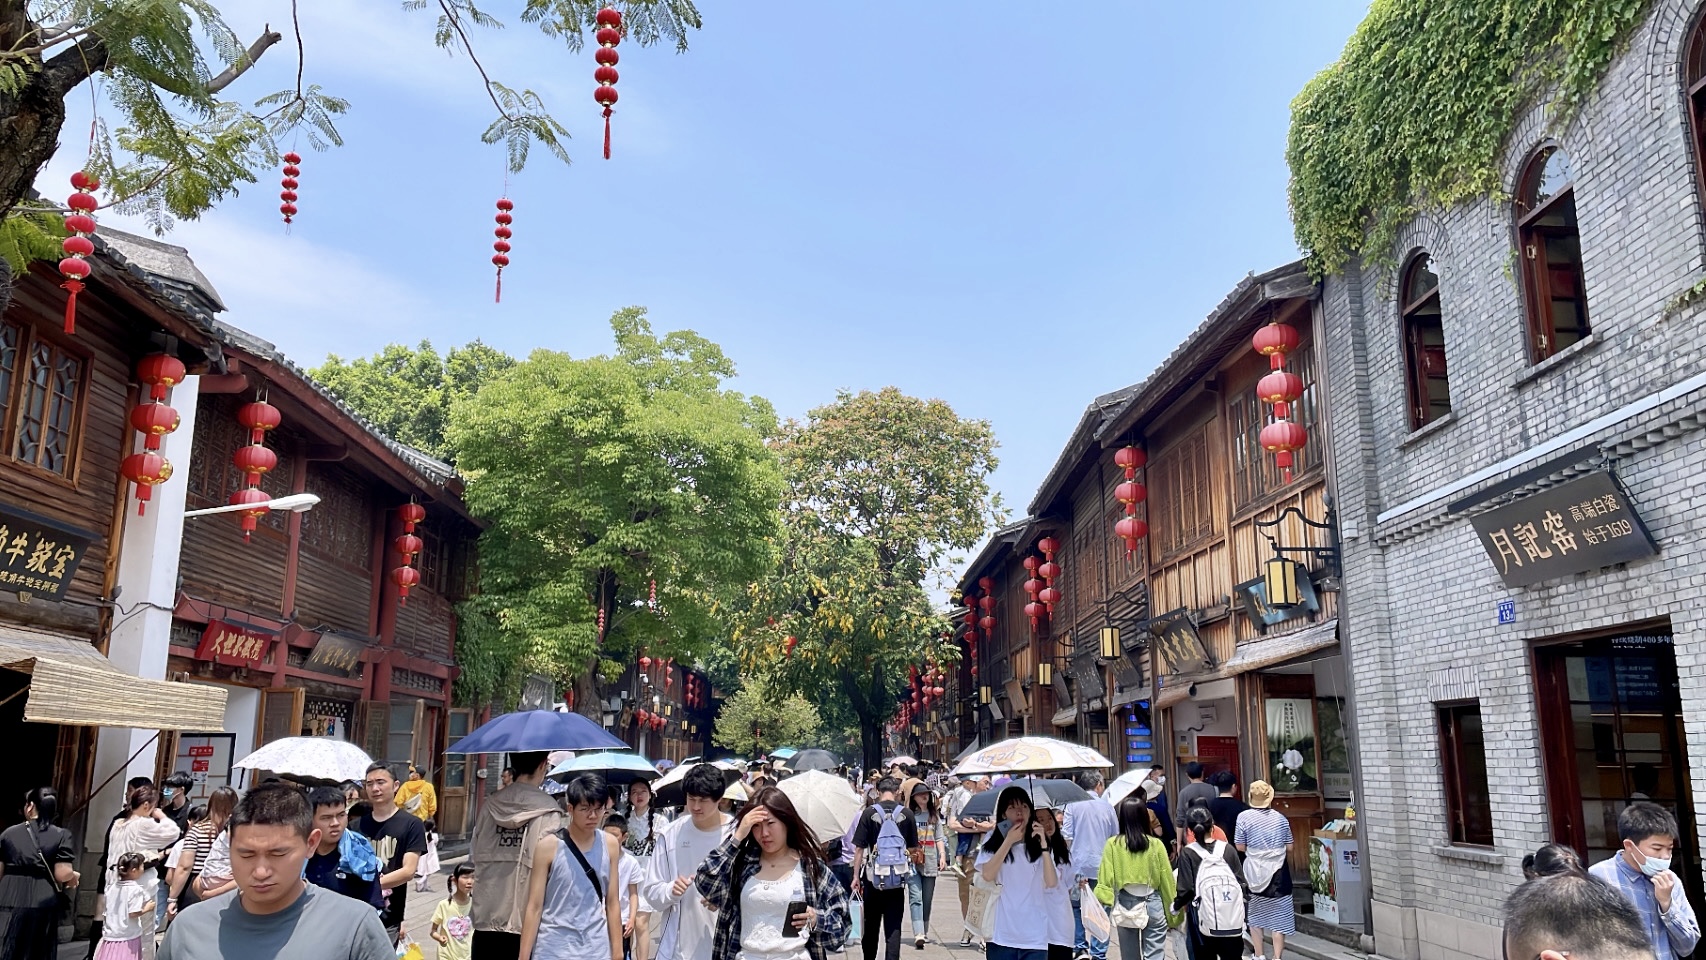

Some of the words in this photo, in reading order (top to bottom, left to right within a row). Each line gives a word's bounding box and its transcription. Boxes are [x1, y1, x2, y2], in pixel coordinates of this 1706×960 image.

[1568, 494, 1620, 523] 高端白瓷
[1582, 519, 1633, 546] 始于1619
[1222, 891, 1231, 901] K
